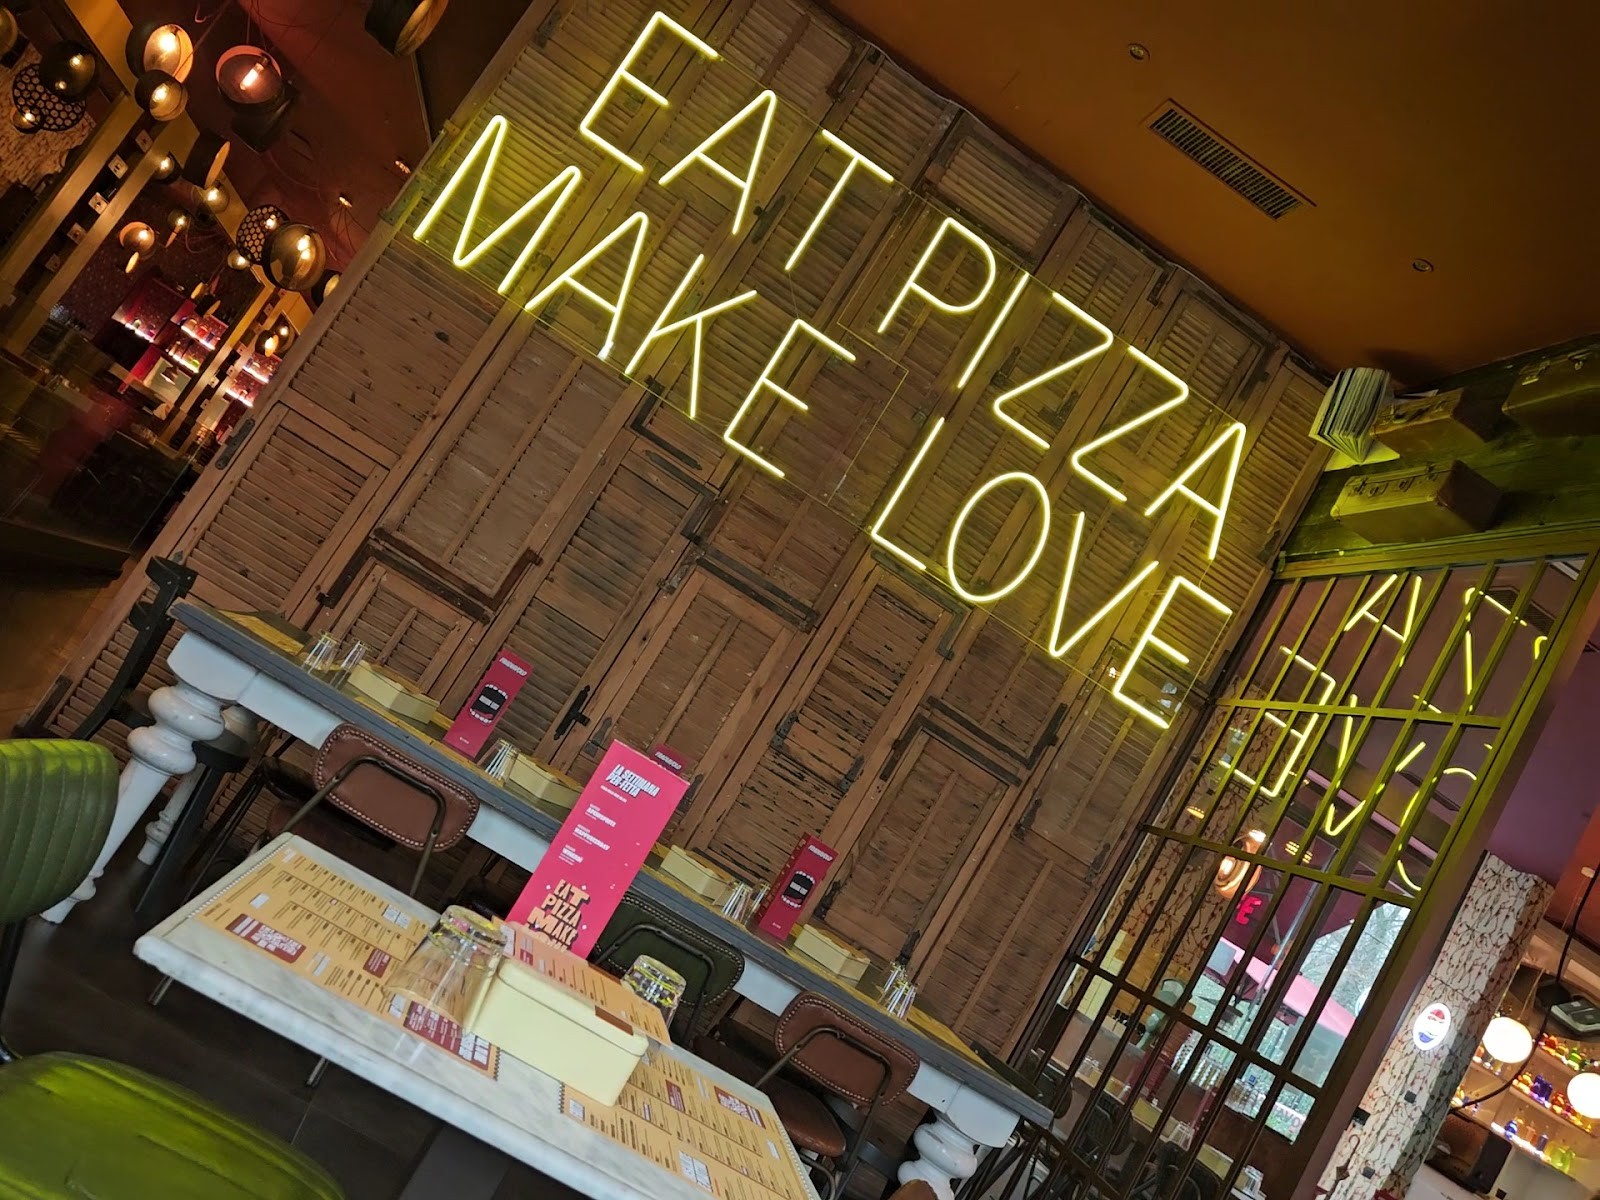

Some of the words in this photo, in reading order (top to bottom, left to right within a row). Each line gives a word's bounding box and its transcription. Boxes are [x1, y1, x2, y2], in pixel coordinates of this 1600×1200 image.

[578, 10, 896, 272] EAT
[877, 216, 1249, 562] PIZZA
[412, 114, 858, 480] MAKE
[870, 416, 1234, 730] LOVE
[541, 893, 581, 929] PIZZA
[553, 879, 590, 907] EAT
[527, 906, 578, 946] MAKE
